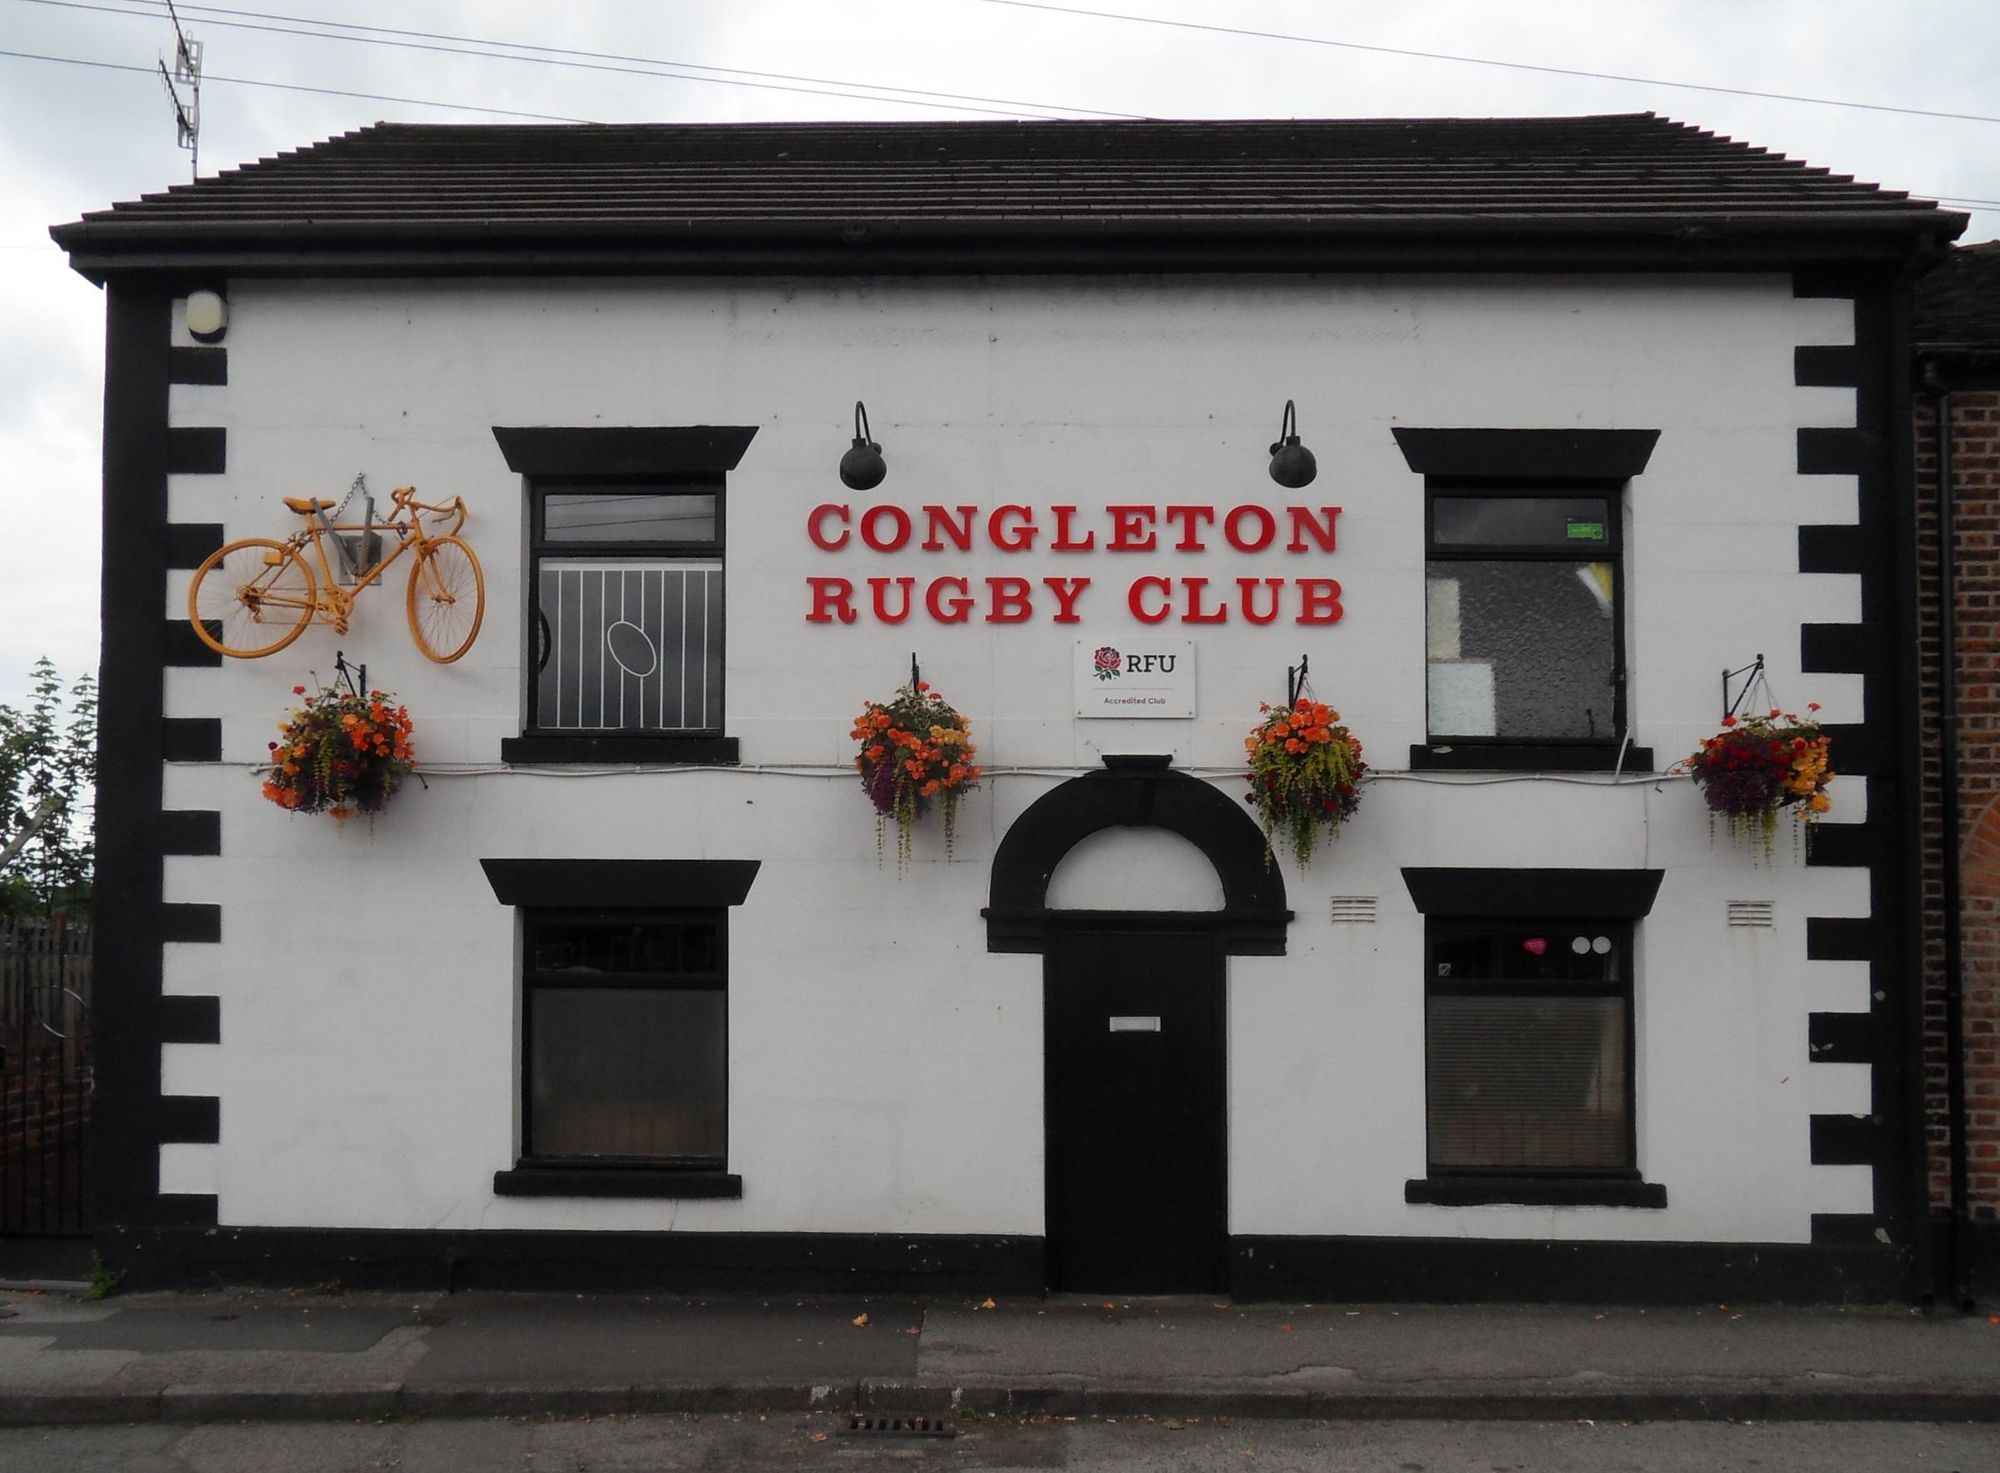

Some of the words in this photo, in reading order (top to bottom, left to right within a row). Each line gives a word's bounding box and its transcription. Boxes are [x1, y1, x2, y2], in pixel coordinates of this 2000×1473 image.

[807, 504, 1342, 553] CONGLETON
[805, 577, 1091, 624] RUGBY
[1127, 577, 1344, 626] CLUB
[1126, 655, 1176, 673] RFU
[1104, 697, 1146, 705] Accredited
[1148, 697, 1166, 705] Club
